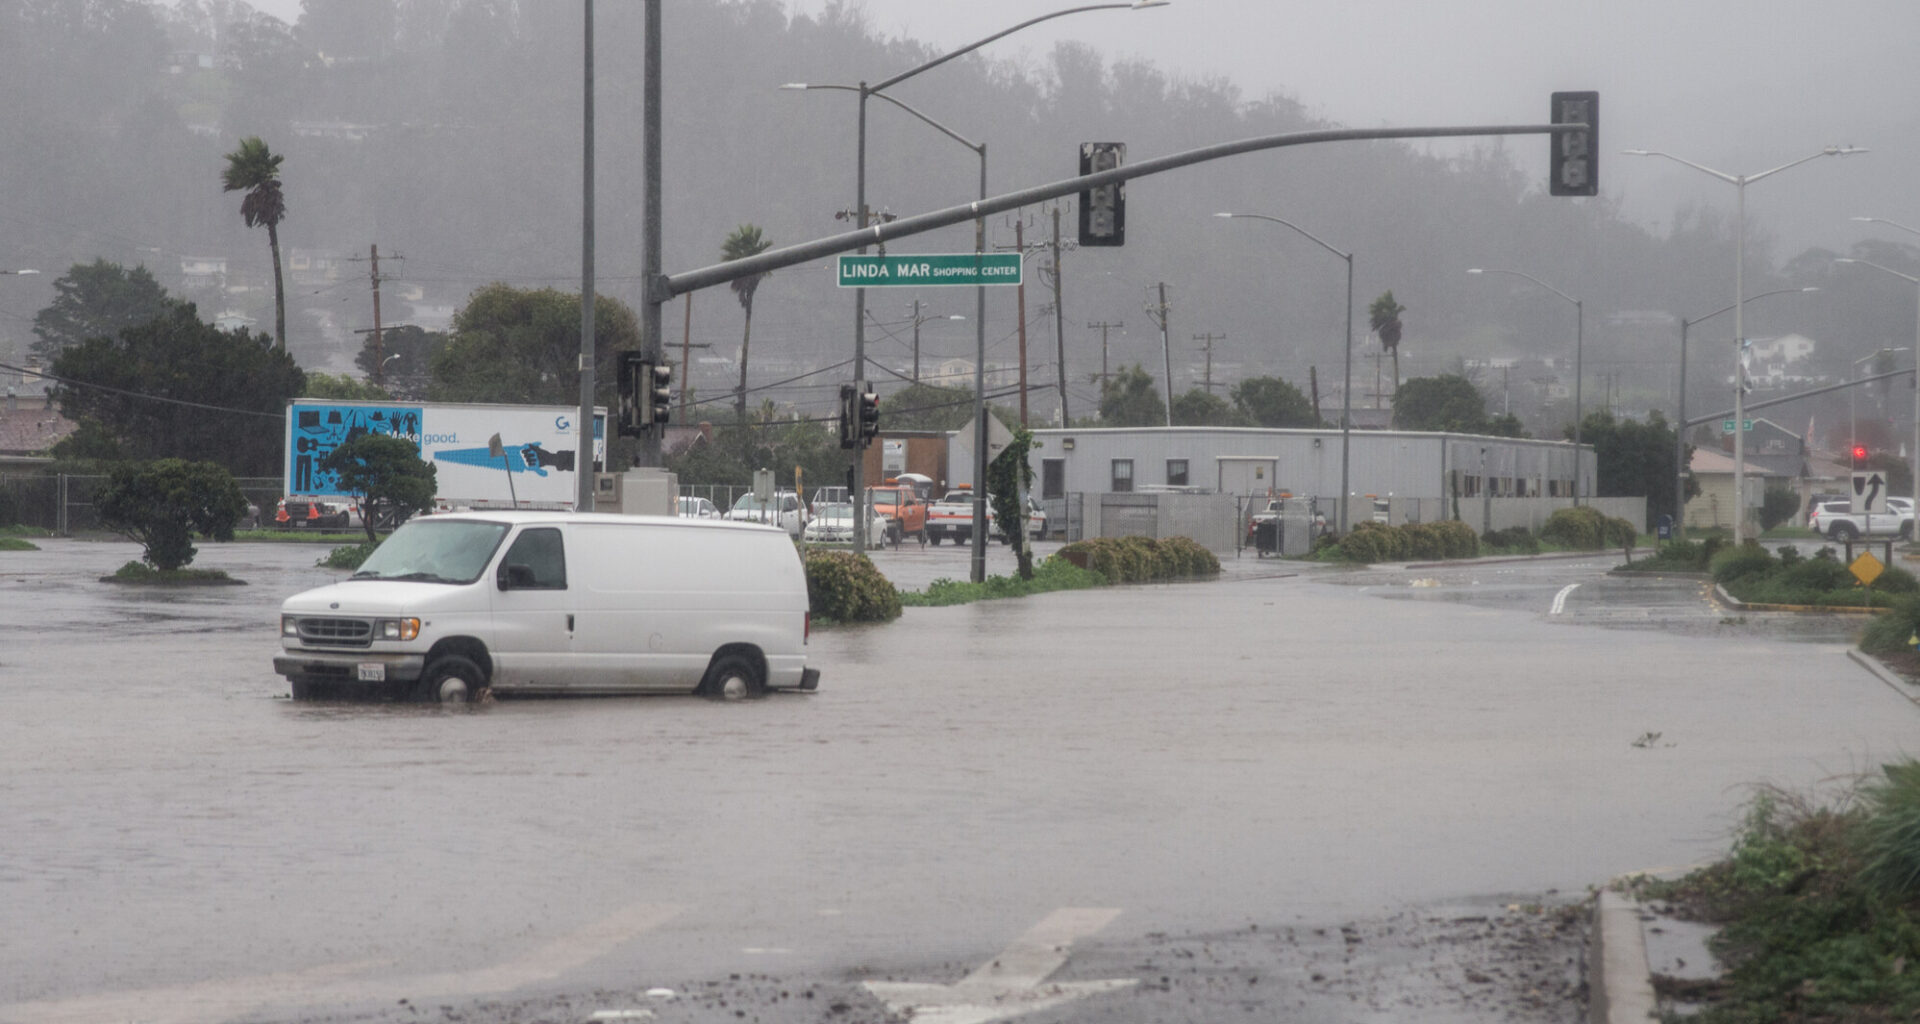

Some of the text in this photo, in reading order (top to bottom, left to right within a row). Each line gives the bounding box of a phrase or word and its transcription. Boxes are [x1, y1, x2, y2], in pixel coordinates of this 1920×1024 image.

[843, 263, 1017, 278] LINDA MAR SHOPPING CENTER
[424, 432, 460, 445] good.
